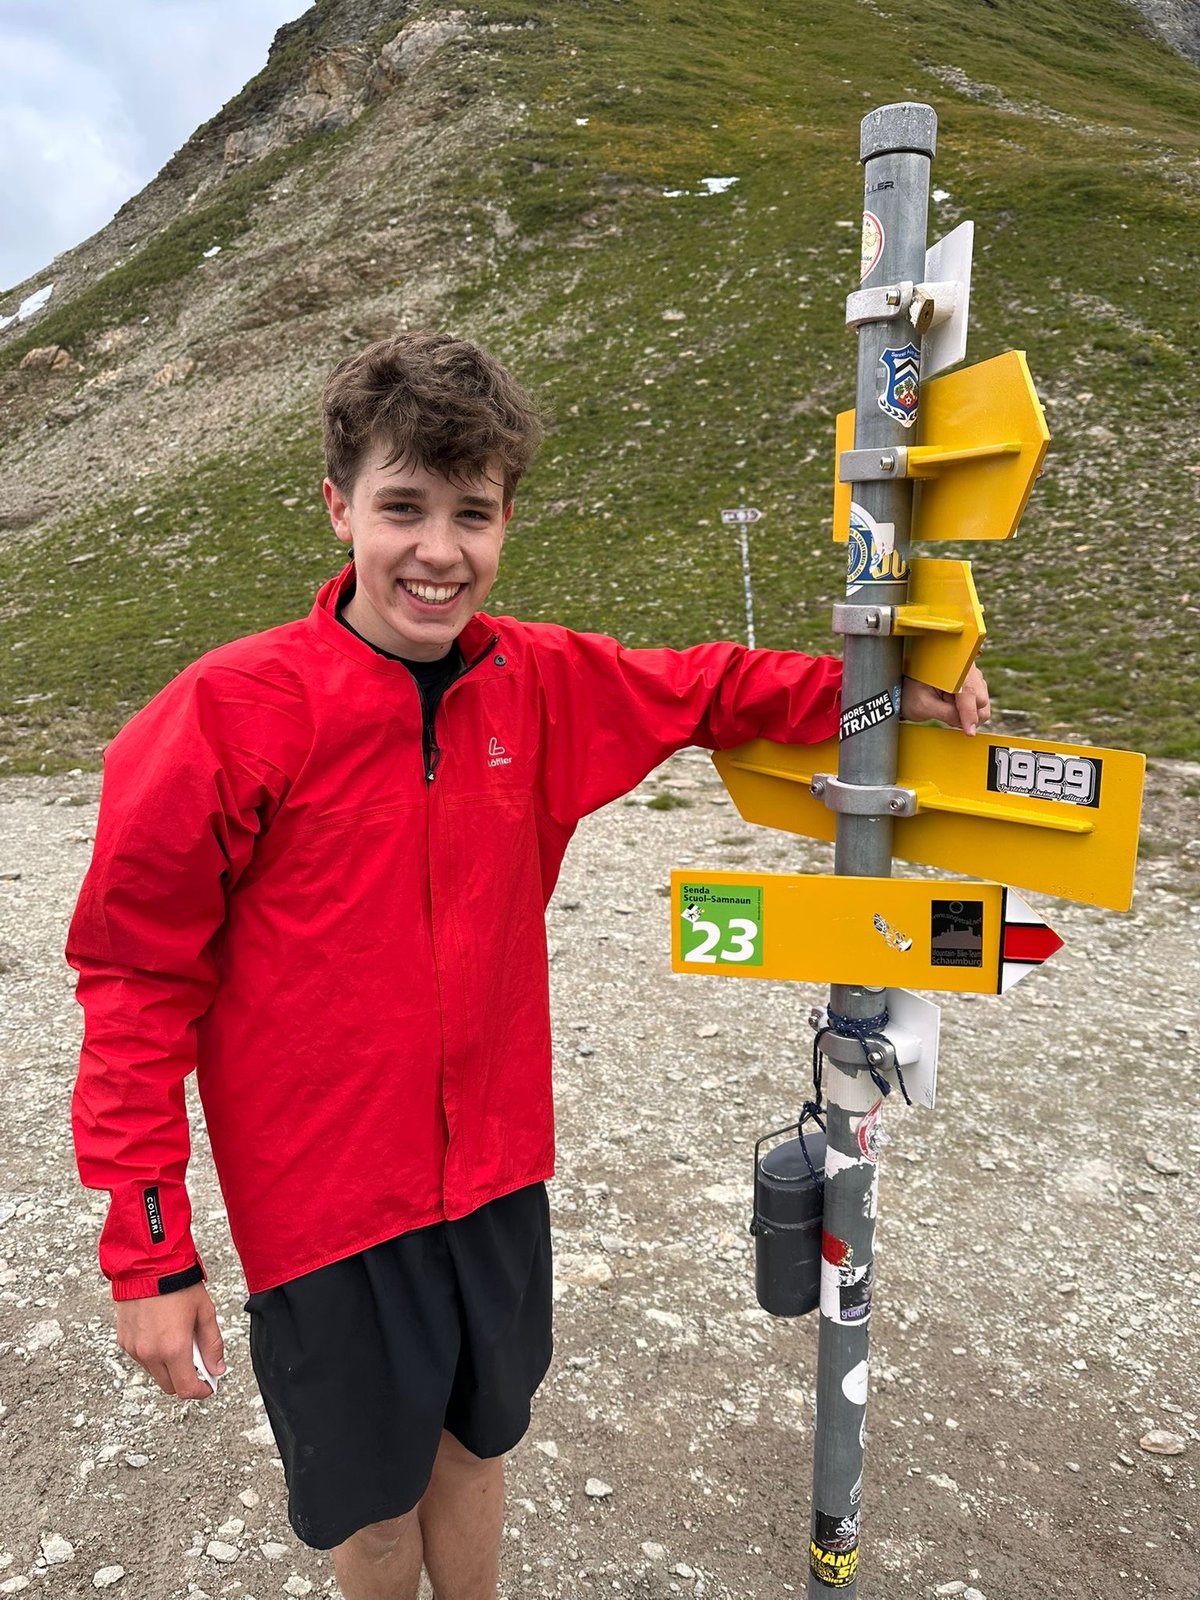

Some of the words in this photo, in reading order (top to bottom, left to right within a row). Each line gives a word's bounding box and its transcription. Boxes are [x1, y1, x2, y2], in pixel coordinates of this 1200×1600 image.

[843, 705, 865, 723] MORE
[866, 693, 890, 711] TIME
[843, 701, 893, 736] TRAILS
[995, 748, 1095, 801] 1929
[683, 886, 710, 894] Senda
[684, 917, 758, 964] 23
[931, 956, 982, 967] Schaumburg
[146, 1196, 159, 1234] COLIBRI
